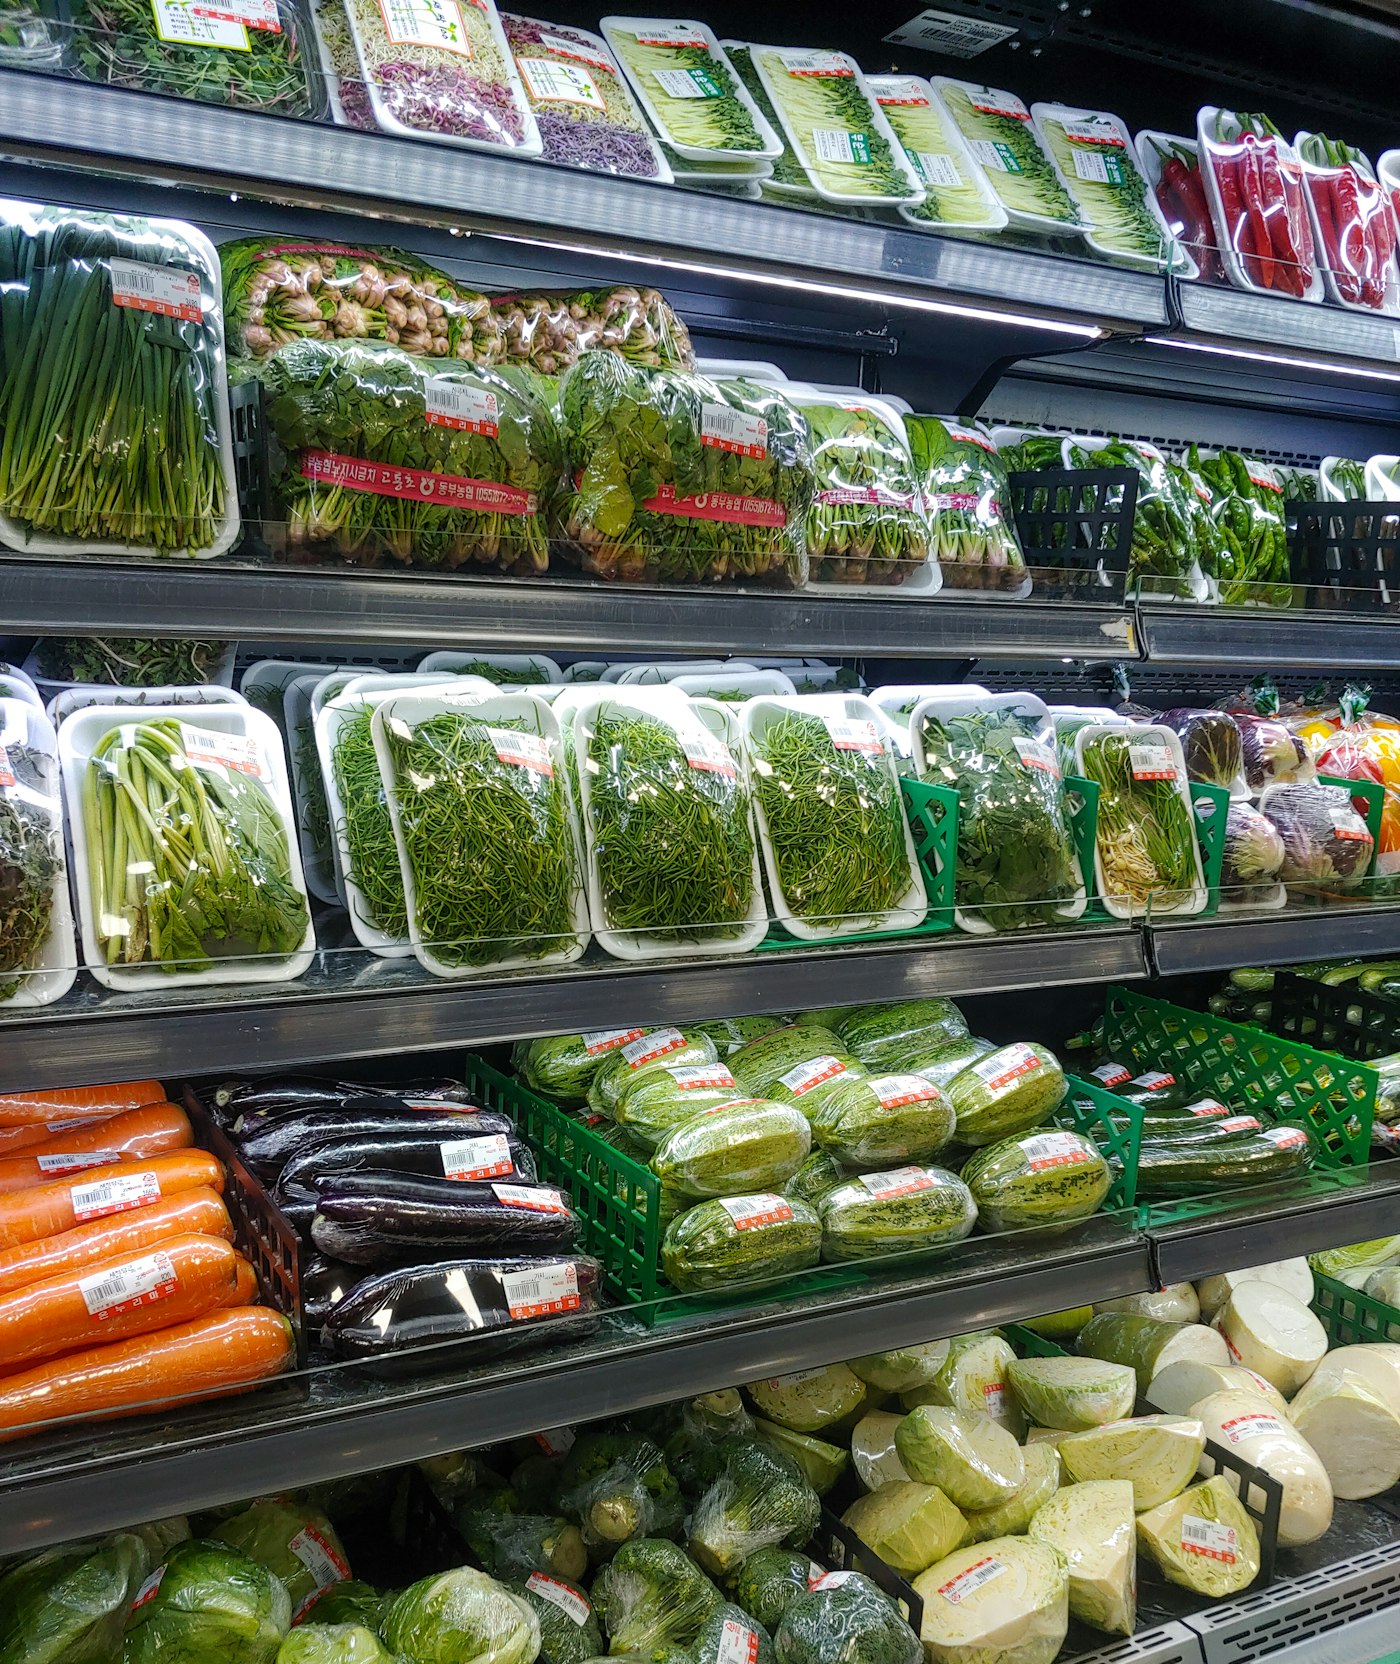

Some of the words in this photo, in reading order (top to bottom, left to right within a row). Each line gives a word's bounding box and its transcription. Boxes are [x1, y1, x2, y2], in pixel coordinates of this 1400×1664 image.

[121, 296, 198, 321] 온누리마트
[431, 414, 495, 436] 온누리마트
[706, 437, 763, 458] 온누리마트
[438, 483, 474, 500] 동부농협
[710, 494, 741, 511] 동부농협
[635, 1042, 683, 1066] 온누리마트
[800, 1063, 842, 1094] 온누리마트
[993, 1059, 1037, 1087] 온누리마트
[1035, 1154, 1083, 1169] 온누리마트
[82, 1197, 157, 1219] 온누리마트
[740, 1210, 789, 1228] 온누리마트
[98, 1284, 176, 1321] 온누리마트
[516, 1300, 576, 1316] 온누리마트
